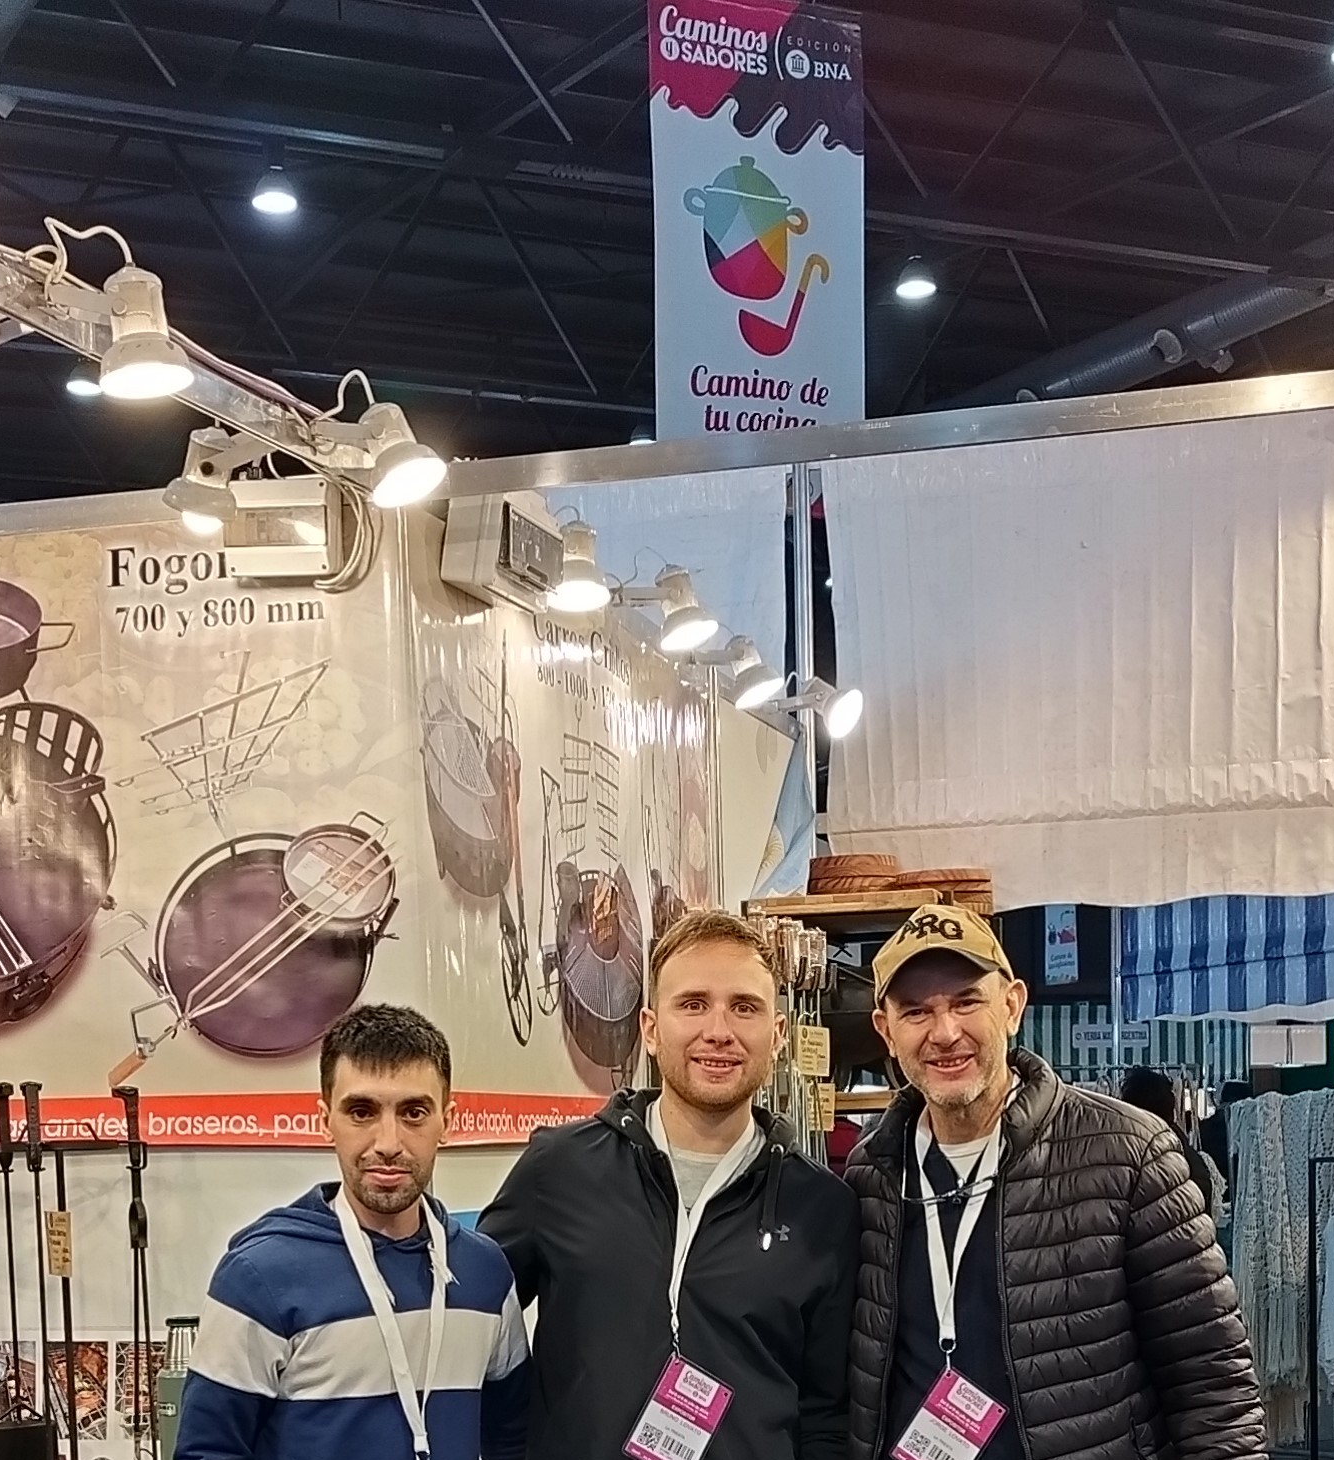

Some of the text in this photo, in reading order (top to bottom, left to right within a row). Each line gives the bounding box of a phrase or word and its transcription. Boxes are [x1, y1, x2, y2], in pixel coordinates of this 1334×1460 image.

[659, 5, 767, 52] Caminos
[787, 36, 852, 53] EDICIÓN
[681, 41, 768, 75] SABORES
[813, 61, 852, 81] BNA
[690, 365, 829, 407] Camino de
[704, 404, 730, 432] tu
[116, 597, 325, 637] 700 y 800 mm
[896, 913, 964, 945] ARG
[148, 1112, 265, 1137] braseros,
[461, 1109, 474, 1132] de
[476, 1107, 517, 1135] chapón,
